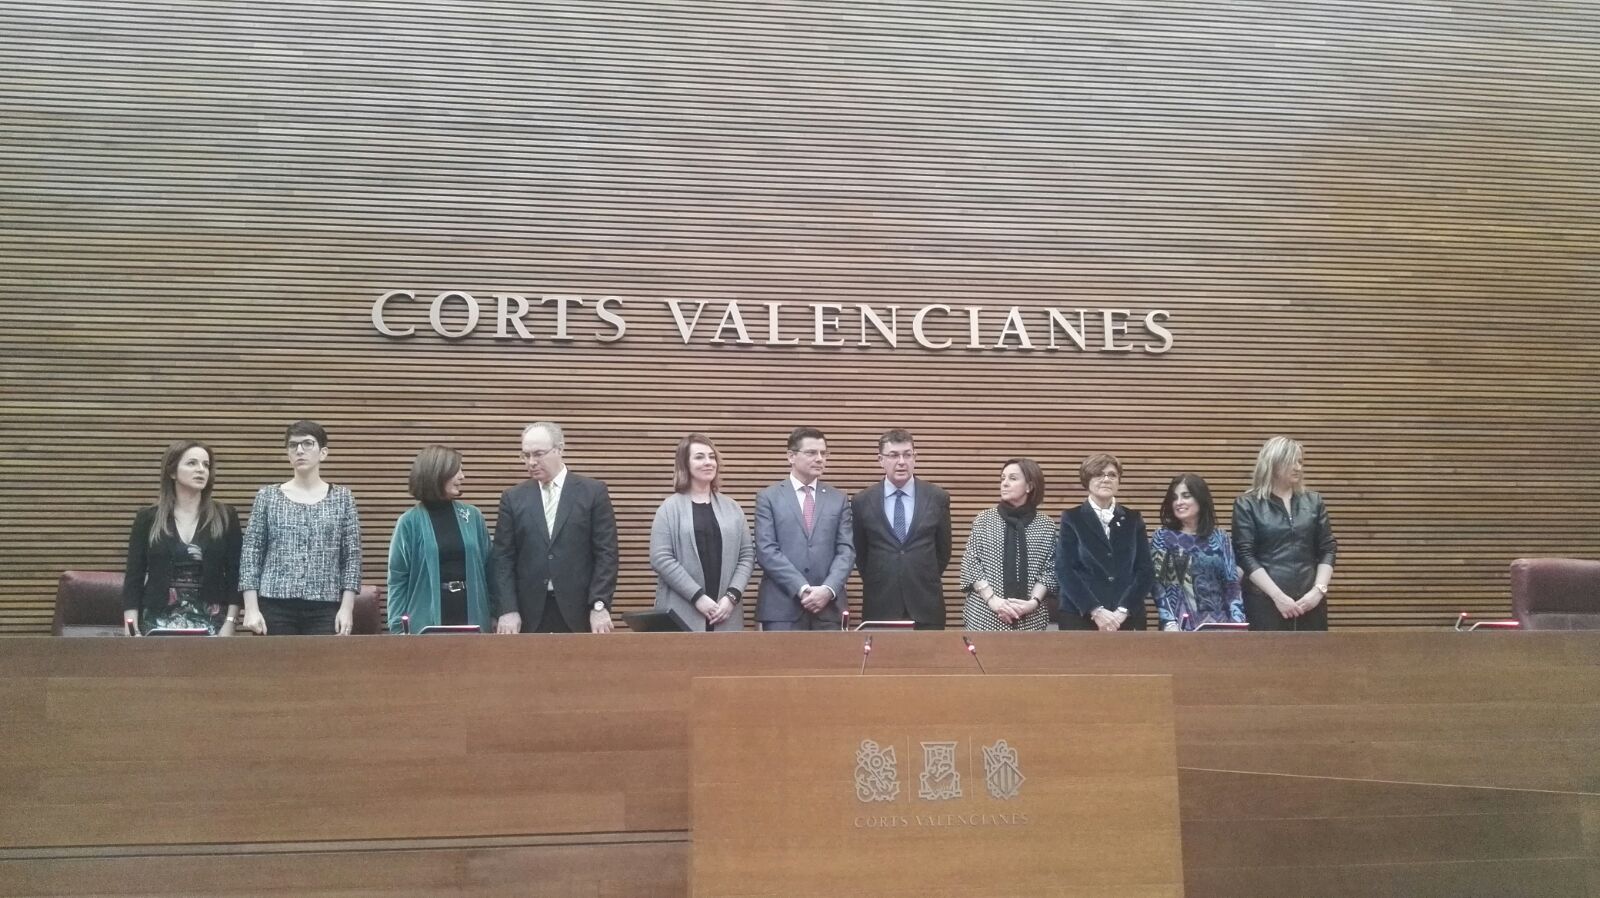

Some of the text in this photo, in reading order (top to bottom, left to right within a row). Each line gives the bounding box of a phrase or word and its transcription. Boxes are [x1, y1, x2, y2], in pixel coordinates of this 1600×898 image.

[371, 289, 1174, 354] CORTS VALENCIANES
[854, 812, 1029, 828] CORTS VALENCIANES
